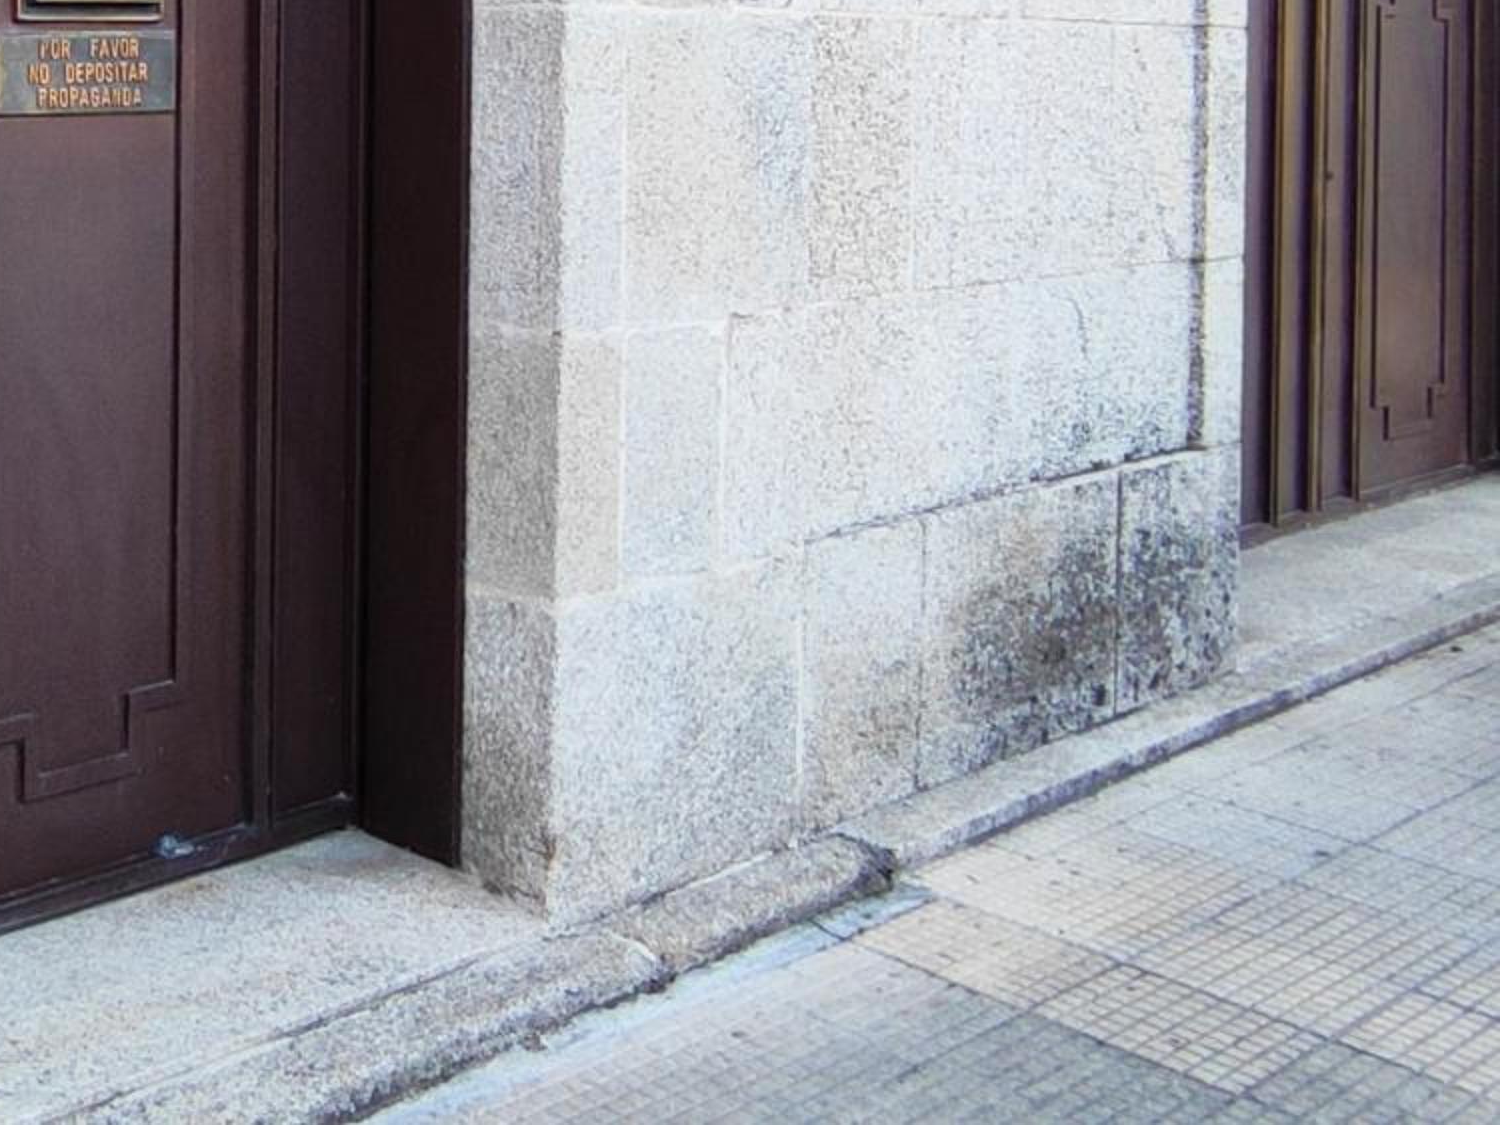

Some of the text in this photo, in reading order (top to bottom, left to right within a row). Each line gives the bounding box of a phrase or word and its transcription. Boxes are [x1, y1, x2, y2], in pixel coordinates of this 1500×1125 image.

[40, 37, 139, 60] POR FAVOR
[27, 61, 149, 84] NO DEPOSITAR
[37, 87, 143, 108] PROPAGANDA
